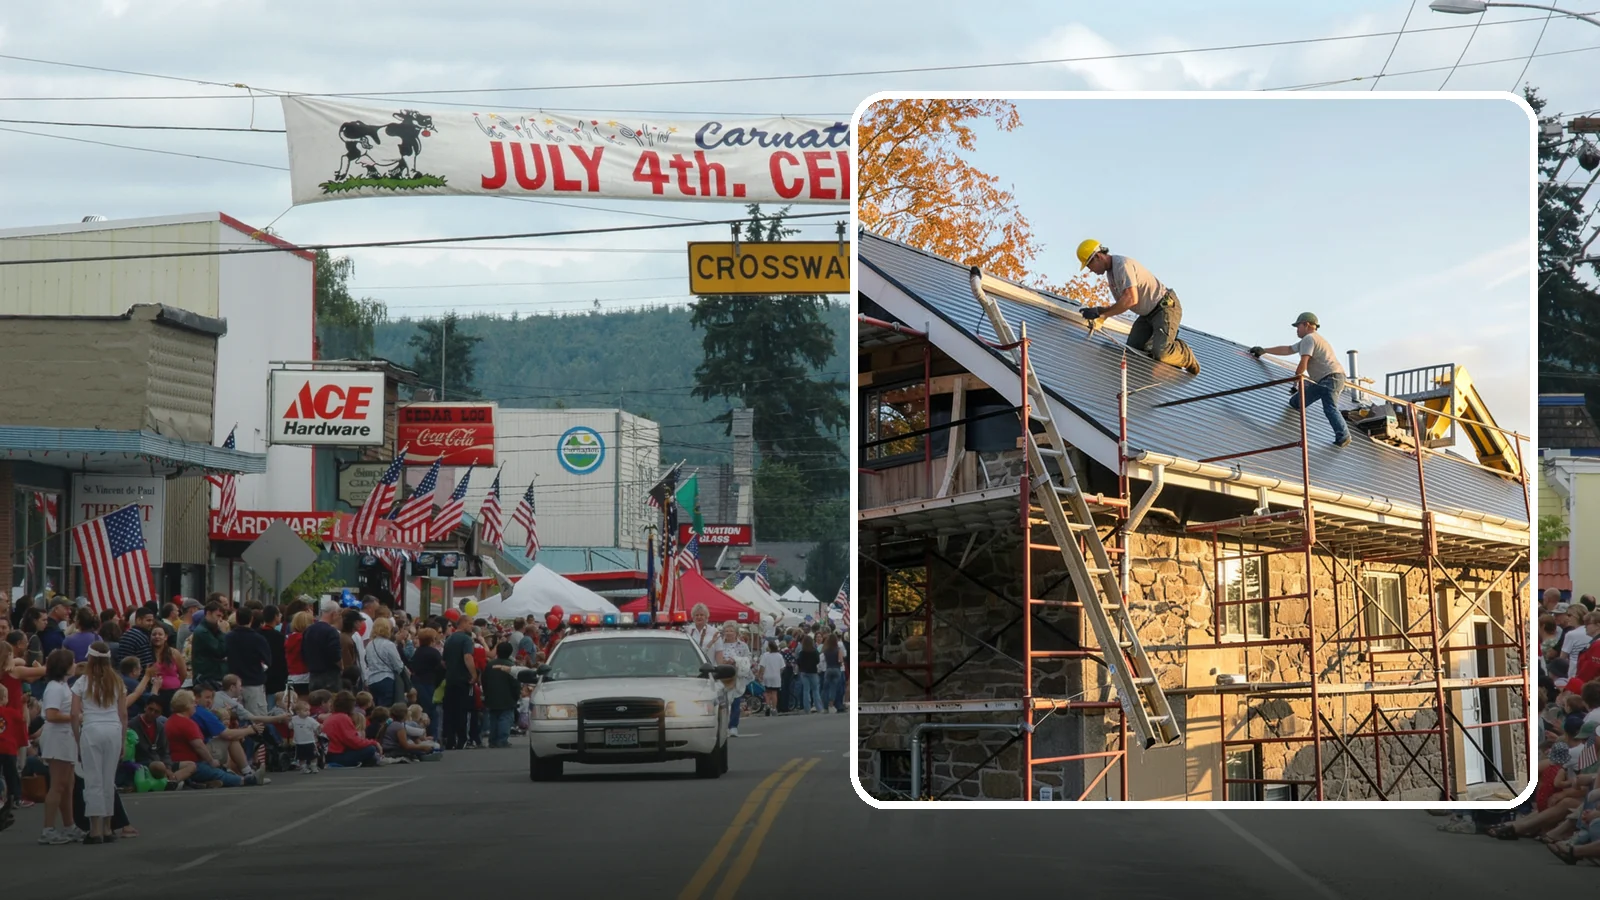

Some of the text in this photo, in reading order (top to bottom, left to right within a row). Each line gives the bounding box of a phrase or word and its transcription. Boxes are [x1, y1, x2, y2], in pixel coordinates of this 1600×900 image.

[695, 121, 850, 149] Carnat
[481, 141, 605, 192] JULY
[632, 150, 746, 197] 4th.
[697, 254, 850, 280] CROSSWA
[282, 380, 373, 420] ACE
[405, 409, 485, 422] CEDAR LOG
[283, 421, 370, 437] Hardware
[416, 428, 477, 447] Coca-Cola
[353, 467, 384, 480] Simpl
[95, 485, 124, 495] Vincent
[126, 486, 136, 495] de
[138, 486, 155, 495] Paul
[212, 515, 331, 536] HRDARE
[688, 526, 741, 535] CRNATION
[699, 535, 730, 543] GLASS
